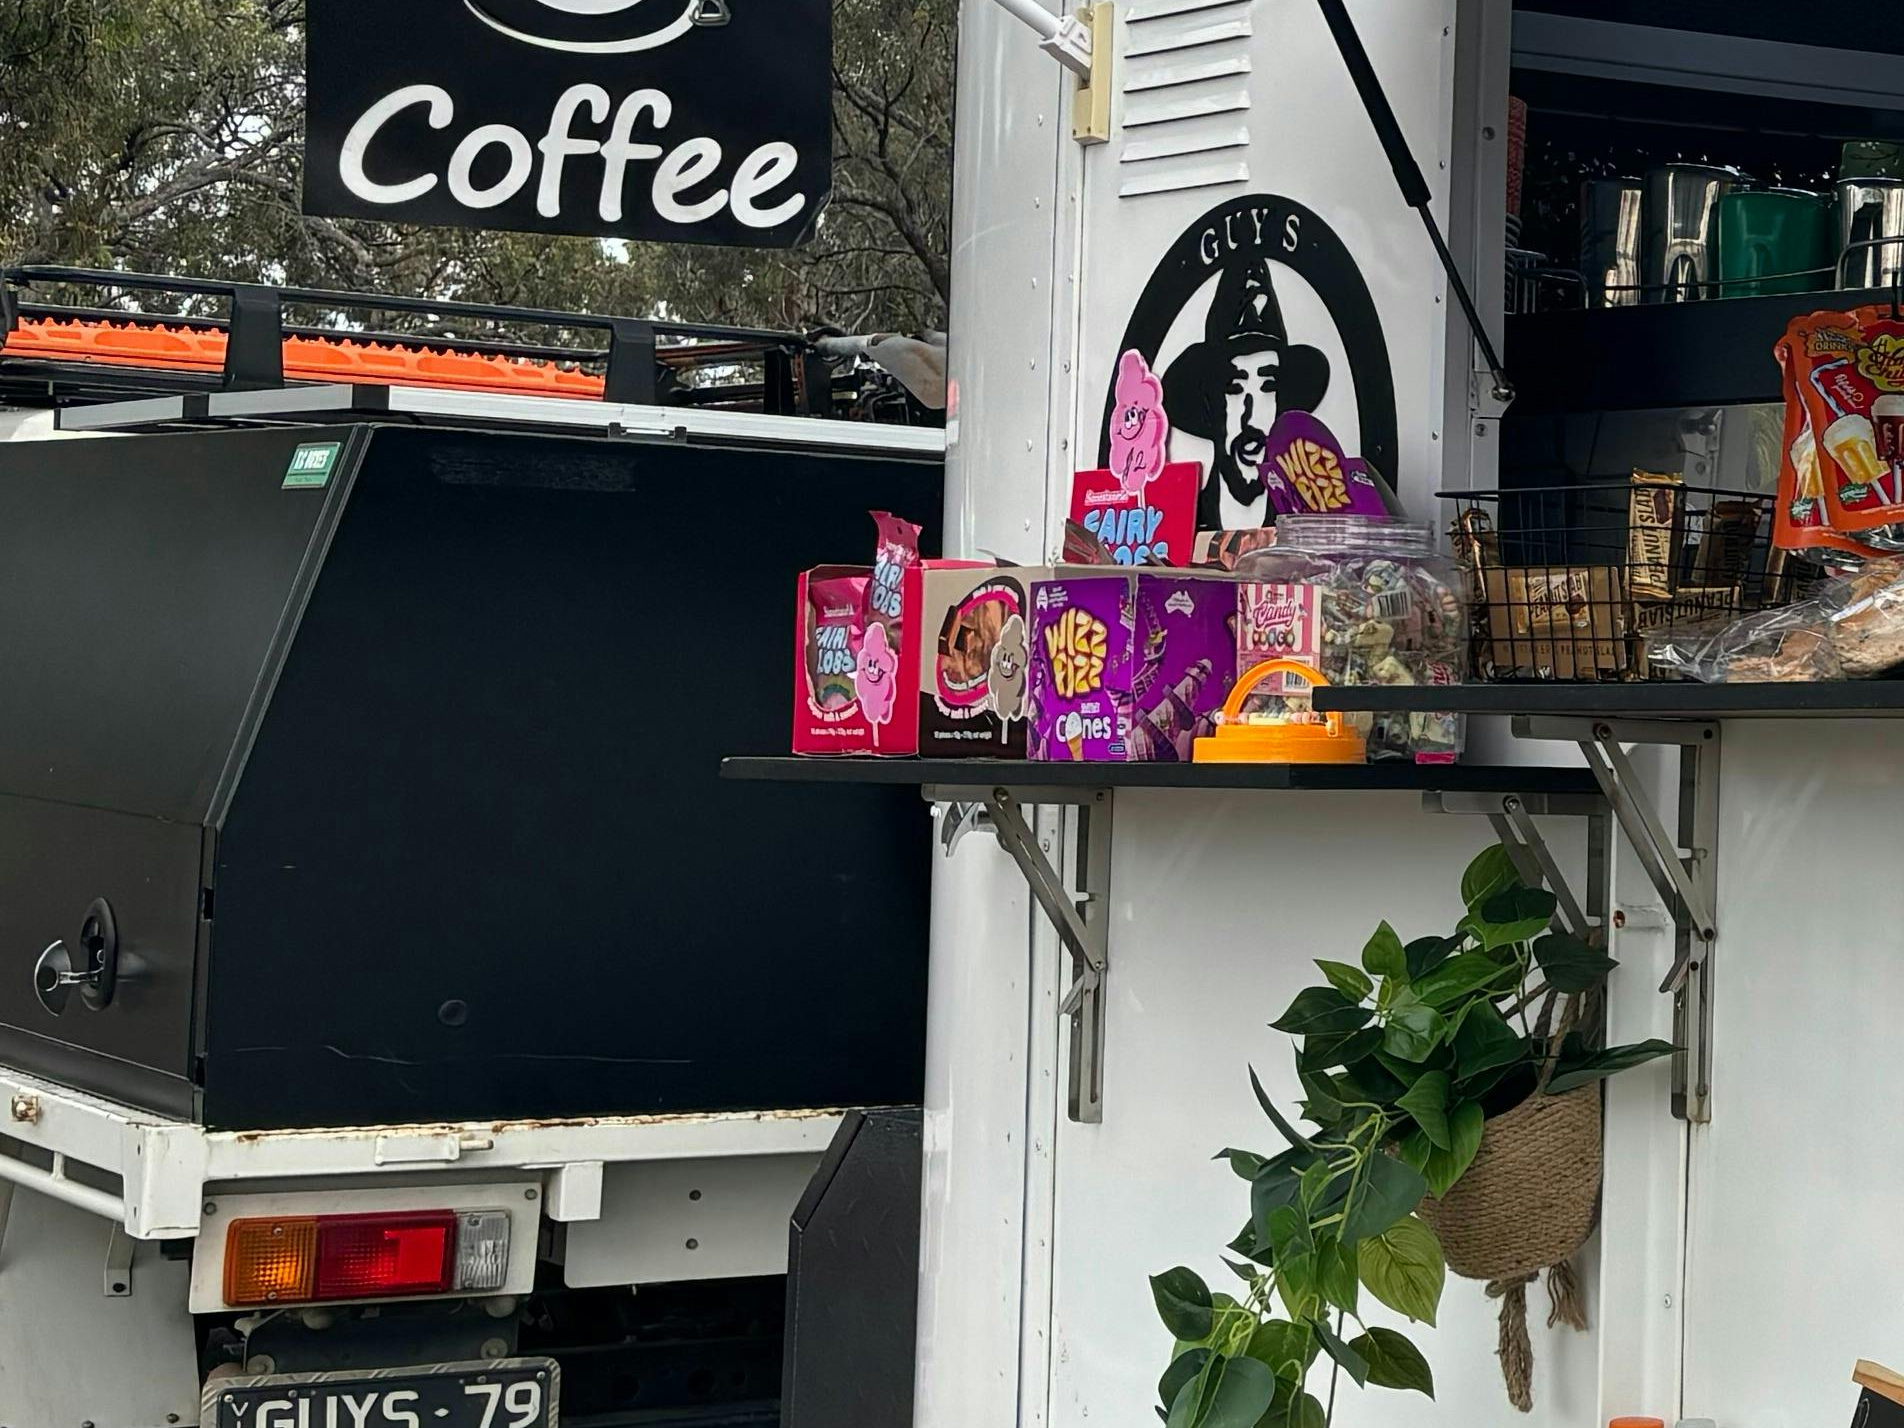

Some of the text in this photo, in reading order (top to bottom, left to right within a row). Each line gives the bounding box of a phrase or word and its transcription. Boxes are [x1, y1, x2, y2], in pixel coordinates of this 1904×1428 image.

[340, 83, 806, 229] Coffee
[1275, 437, 1344, 483] WIZZ
[1044, 607, 1108, 659] WIZZ
[1252, 599, 1298, 629] Candy
[1052, 650, 1105, 698] FIZZ
